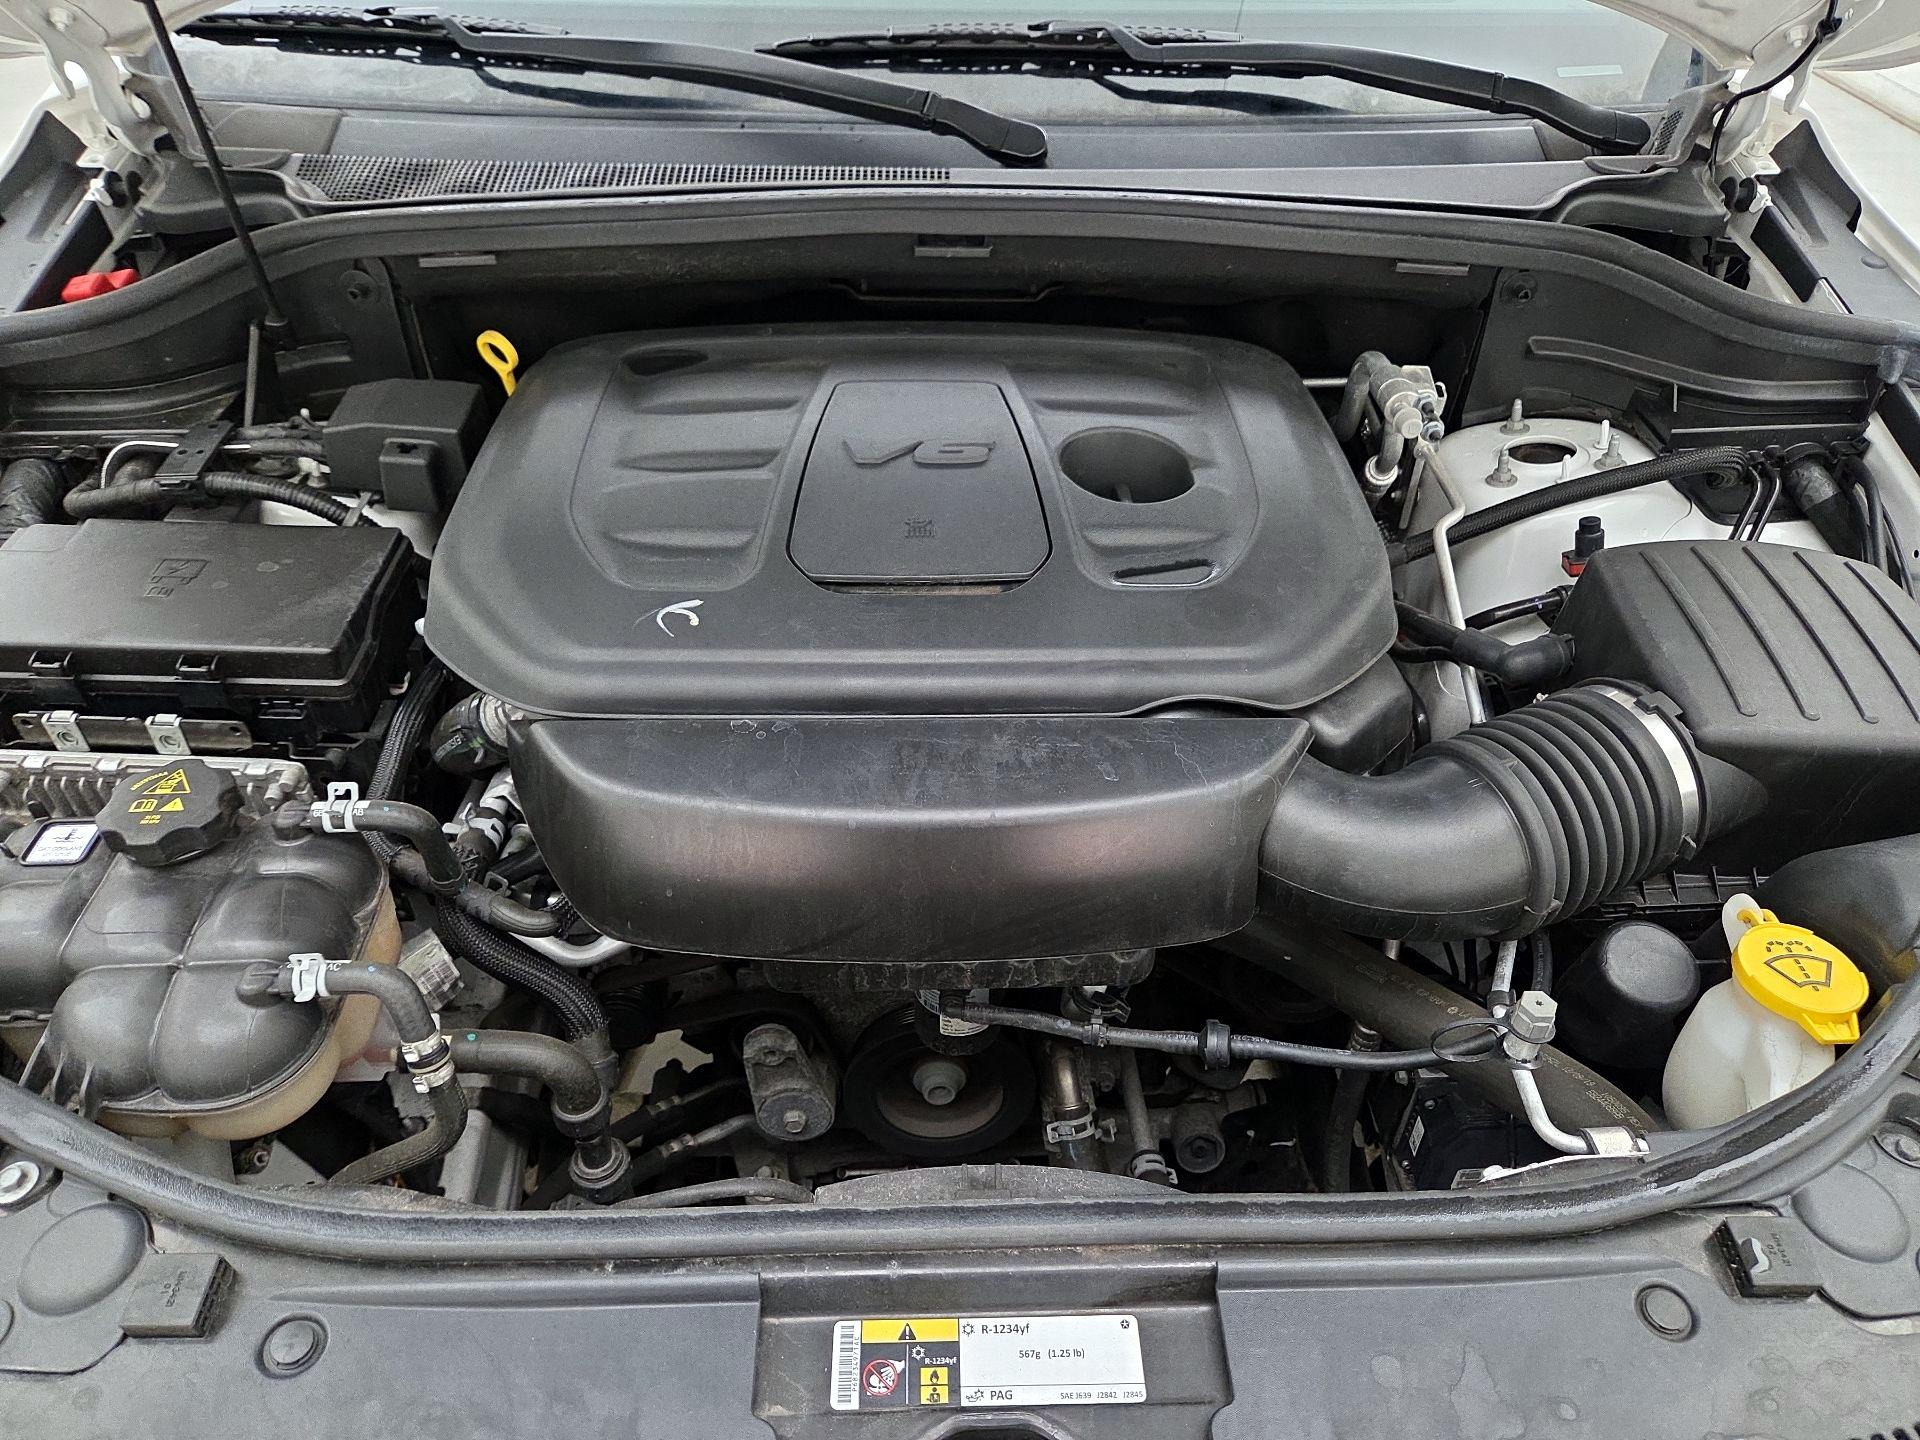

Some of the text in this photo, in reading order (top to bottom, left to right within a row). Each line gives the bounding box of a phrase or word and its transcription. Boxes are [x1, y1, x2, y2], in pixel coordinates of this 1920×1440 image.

[841, 438, 996, 469] V6
[981, 1323, 1030, 1335] R-1234yf
[1018, 1348, 1085, 1360] 567g (1.25 lb)
[924, 1357, 958, 1366] R-1234yf
[990, 1390, 1013, 1400] PAG
[1060, 1391, 1143, 1400] SAE J639 J2842 J2845
